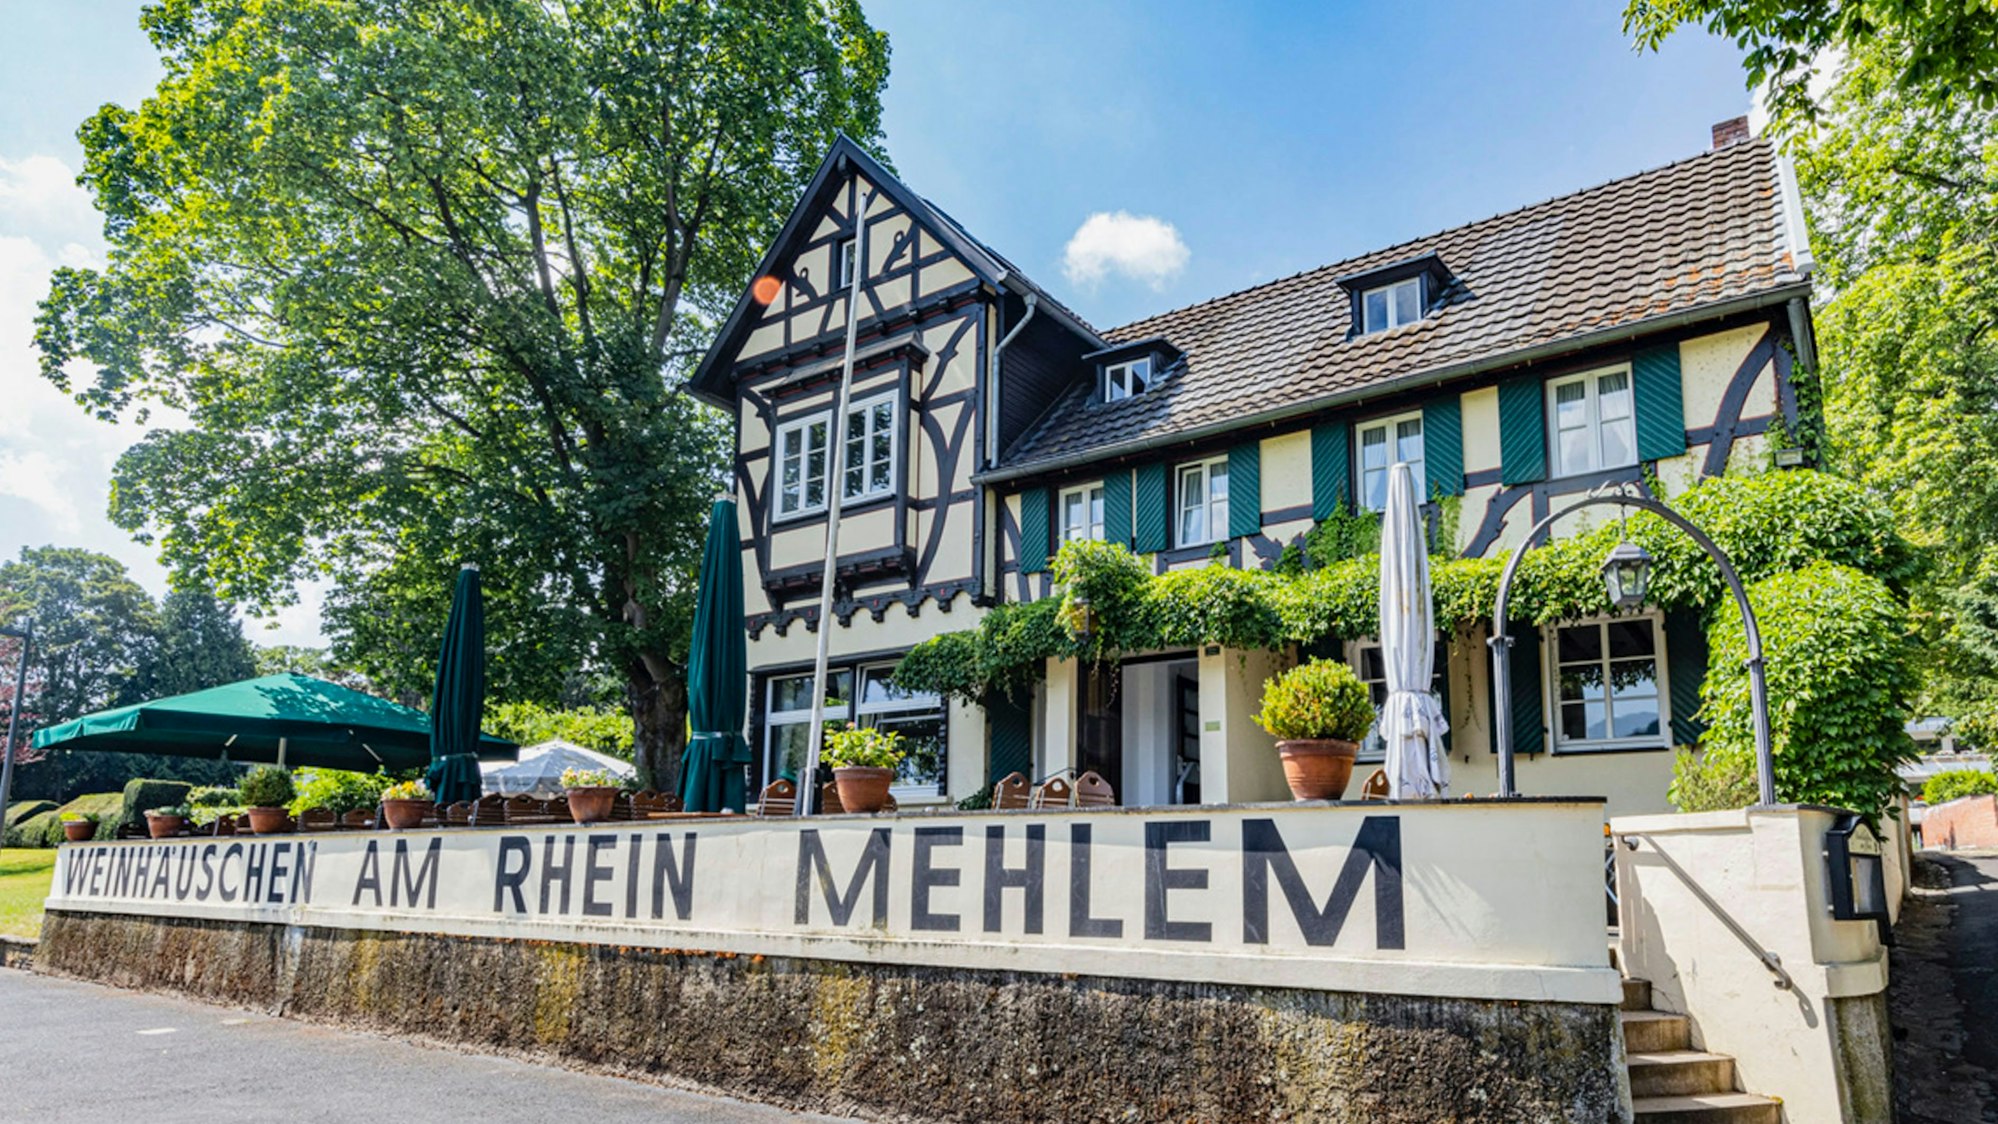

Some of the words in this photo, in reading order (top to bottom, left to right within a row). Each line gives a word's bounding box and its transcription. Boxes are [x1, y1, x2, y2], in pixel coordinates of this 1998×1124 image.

[66, 841, 318, 904] WEINHÄUSCHEN
[352, 837, 442, 909] AM
[493, 832, 698, 920] RHEIN
[794, 816, 1406, 950] MEHLEM
